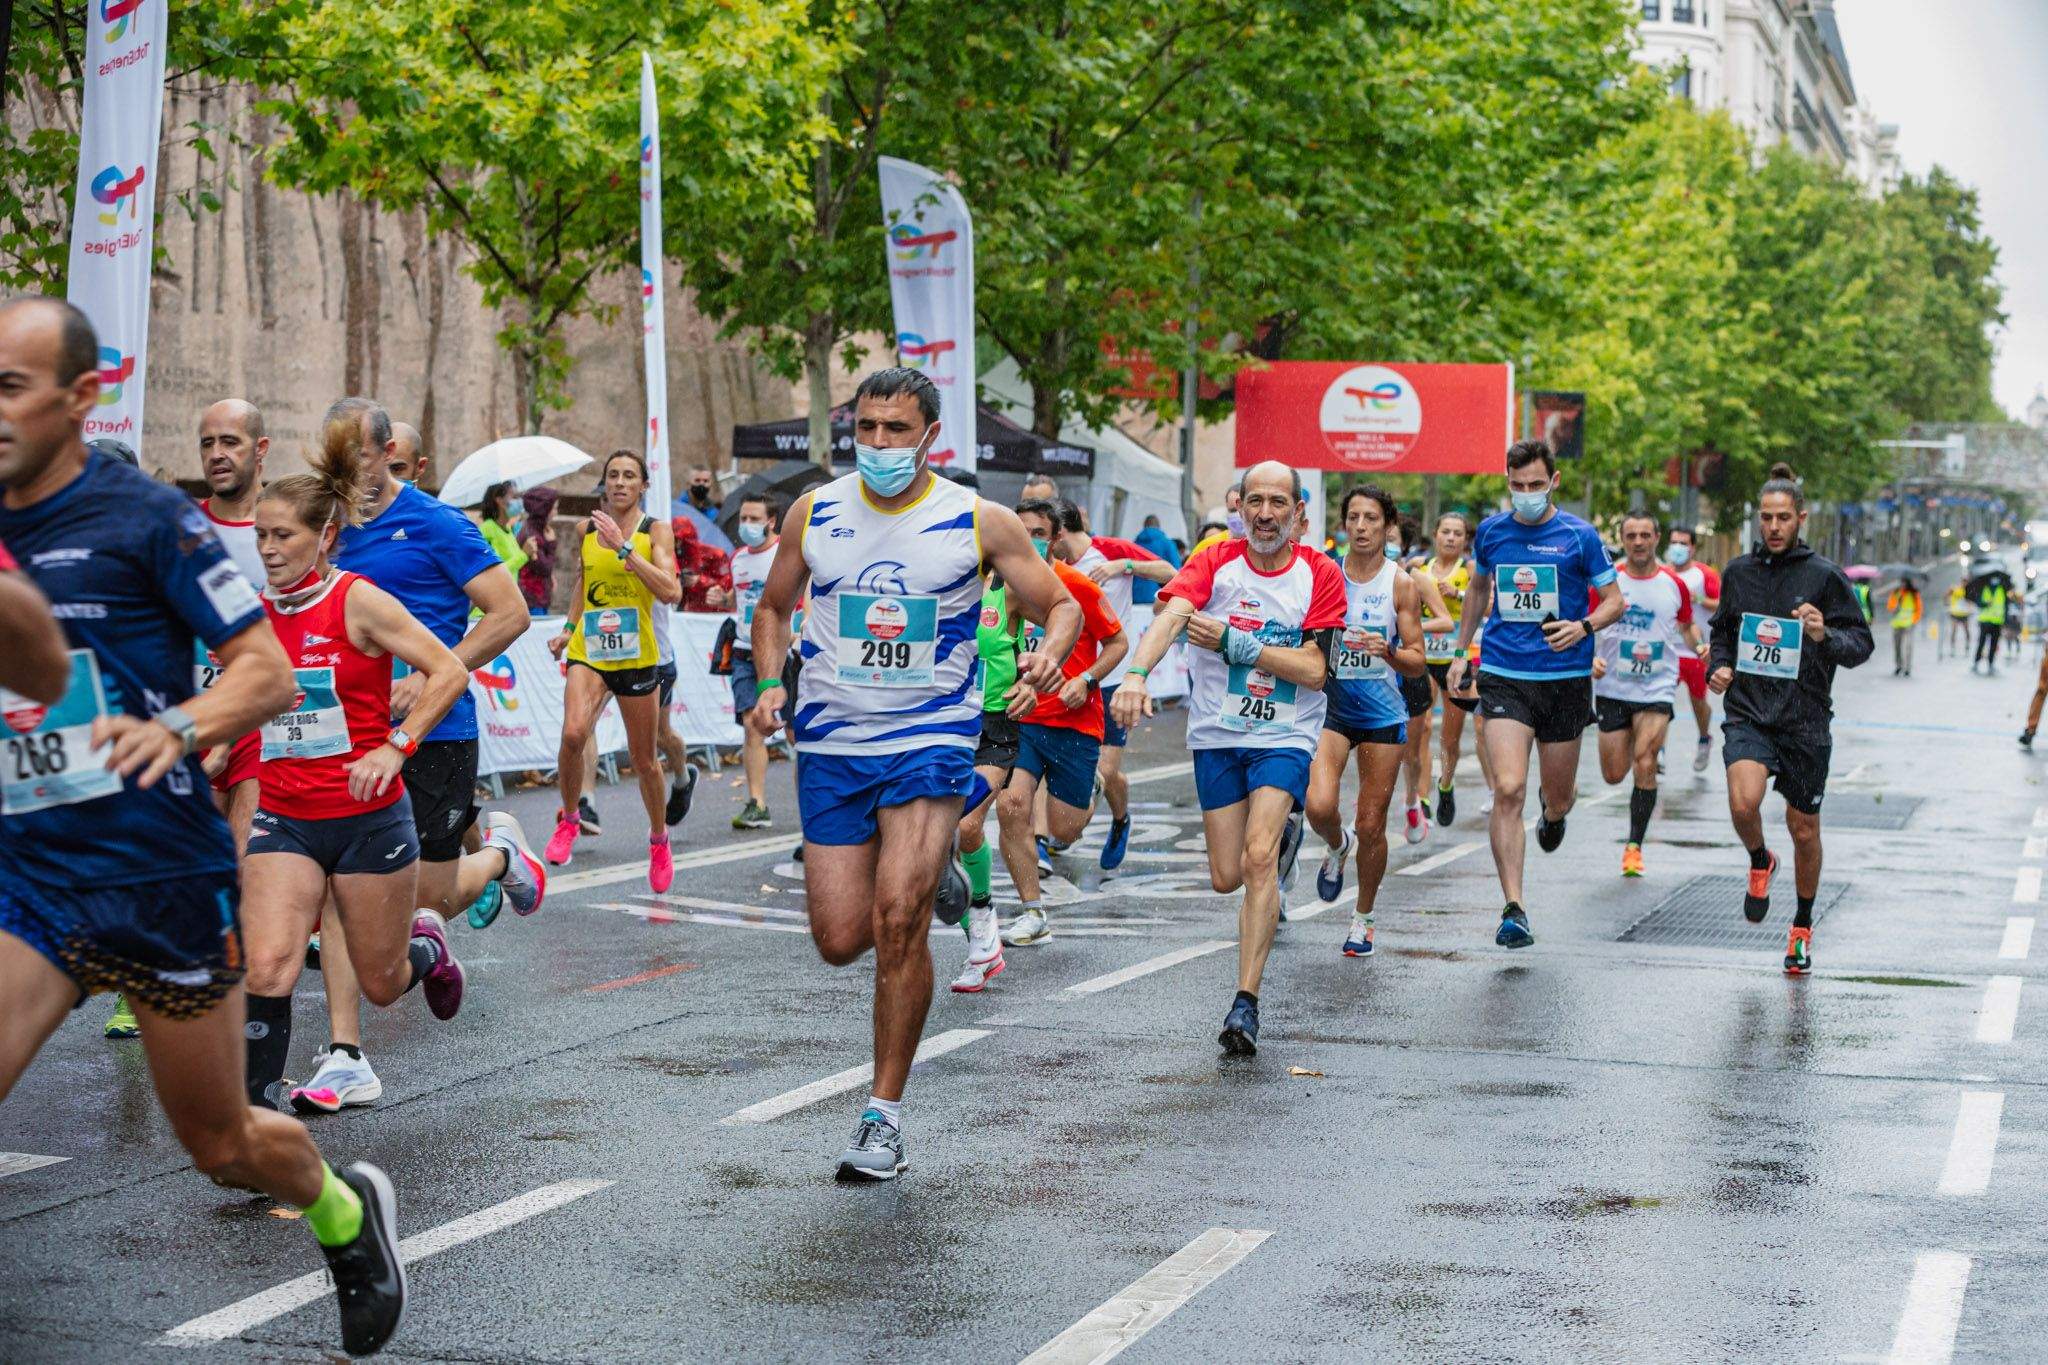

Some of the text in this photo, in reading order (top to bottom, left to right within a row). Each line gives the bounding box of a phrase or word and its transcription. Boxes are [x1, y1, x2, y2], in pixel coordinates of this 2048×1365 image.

[1513, 593, 1541, 609] 246
[600, 634, 623, 649] 261
[861, 640, 911, 669] 299
[1340, 651, 1371, 668] 250
[1753, 645, 1781, 665] 276
[1631, 660, 1652, 673] 275
[1239, 696, 1276, 721] 245
[287, 726, 302, 741] 39
[9, 732, 68, 780] 268
